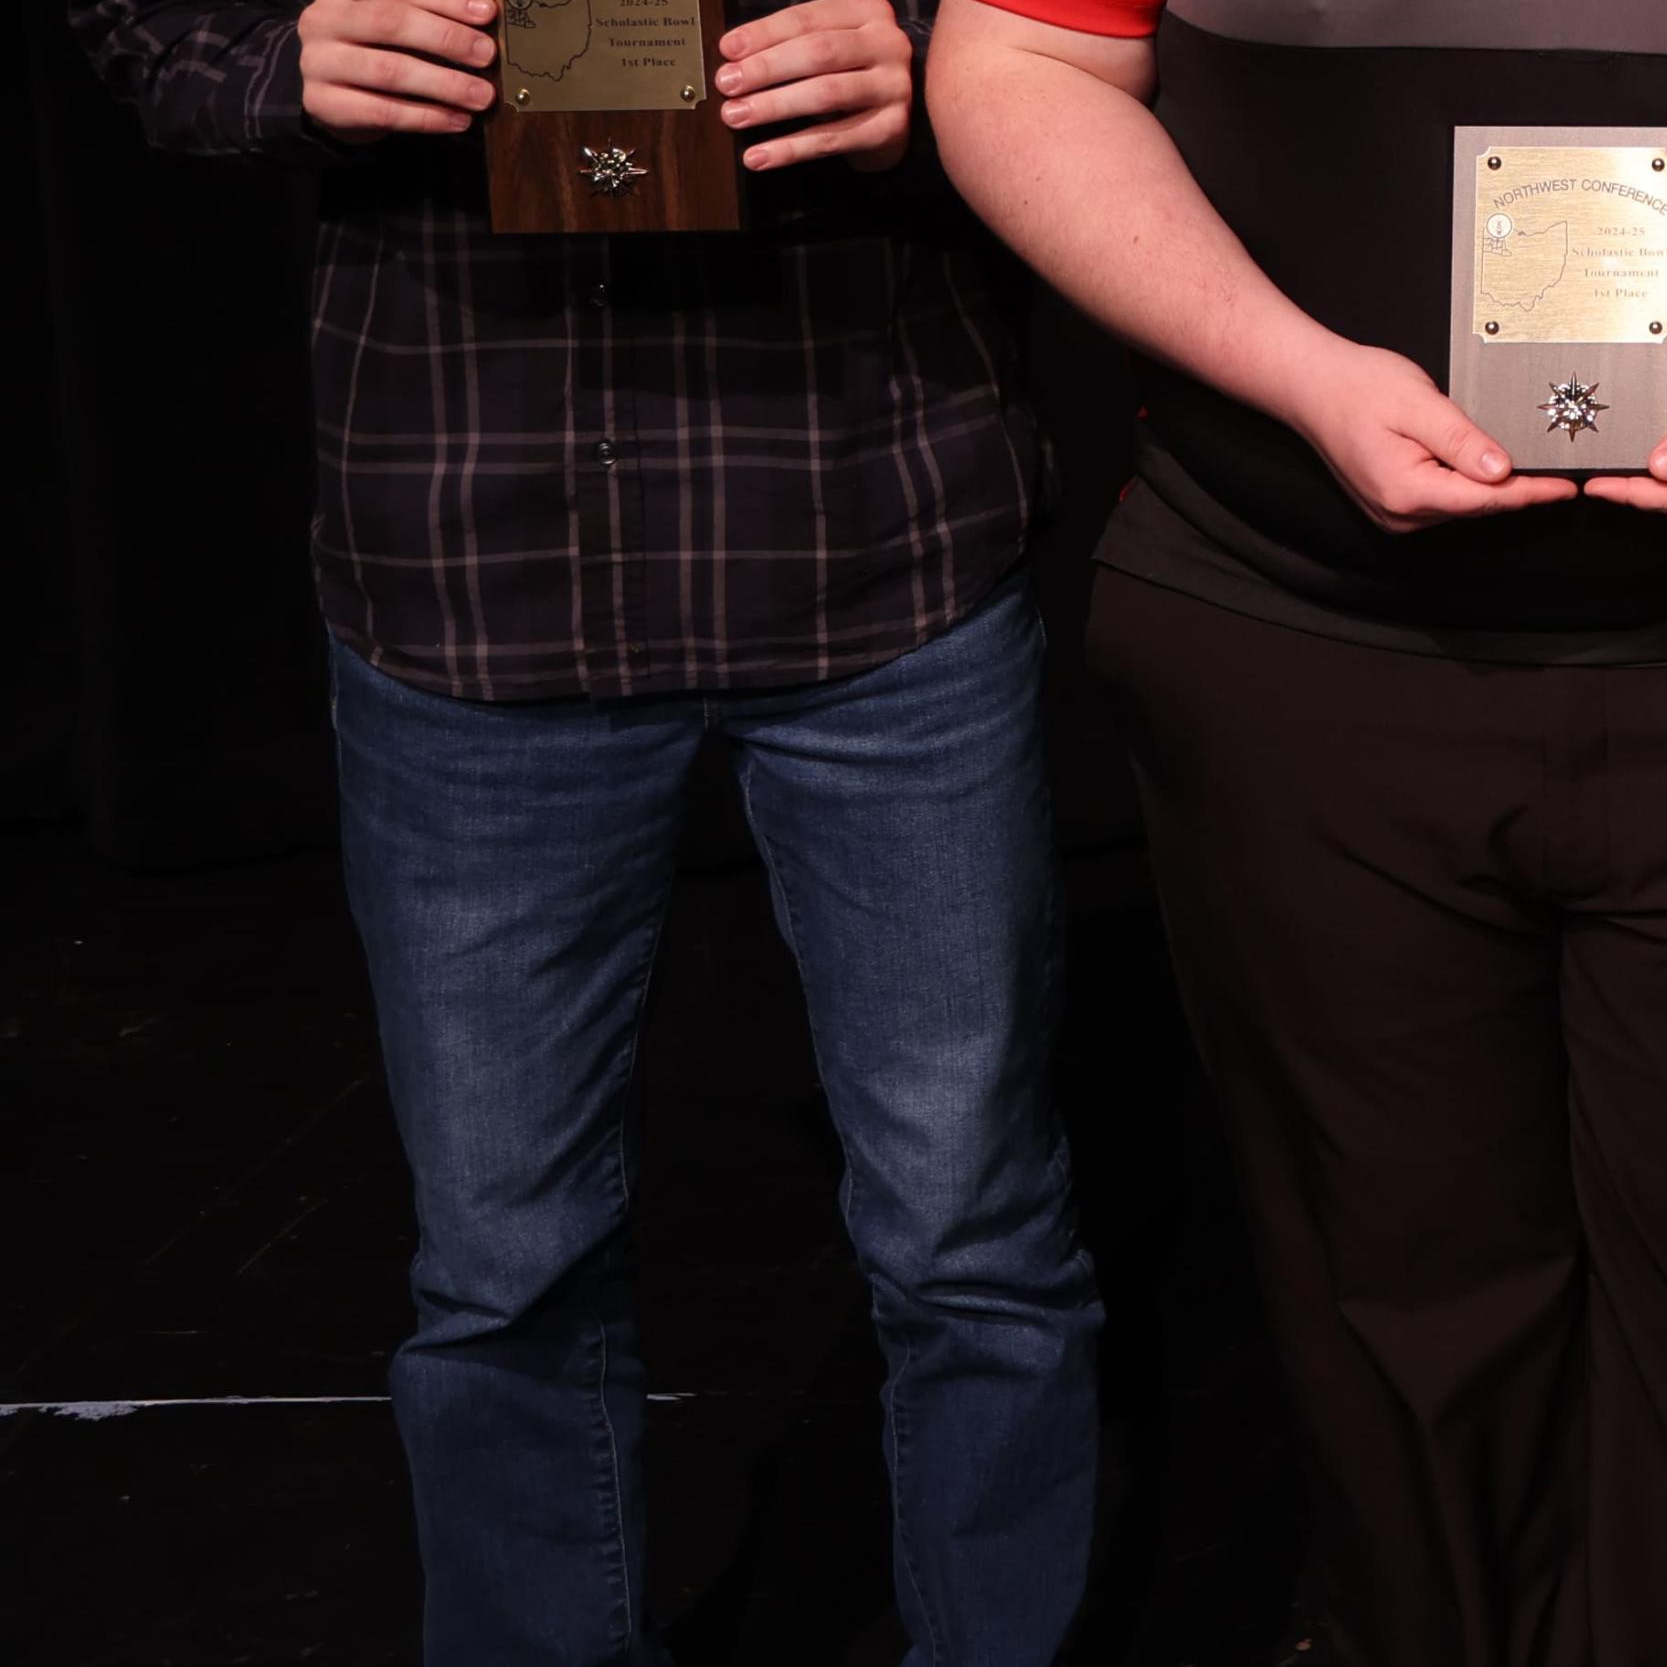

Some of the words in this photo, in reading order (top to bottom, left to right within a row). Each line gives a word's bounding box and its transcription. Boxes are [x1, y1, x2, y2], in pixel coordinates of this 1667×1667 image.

[596, 17, 658, 27] Scholastic
[663, 17, 695, 26] Bowl
[610, 38, 685, 47] Tournament
[622, 59, 638, 67] 1st
[643, 57, 675, 66] Place
[1493, 179, 1576, 209] NORTHWEST
[1597, 227, 1646, 235] 2024-25
[1572, 247, 1634, 256] Scholastic
[1584, 268, 1659, 277] Tournament
[1594, 289, 1610, 297] 1st
[1616, 289, 1647, 298] Place
